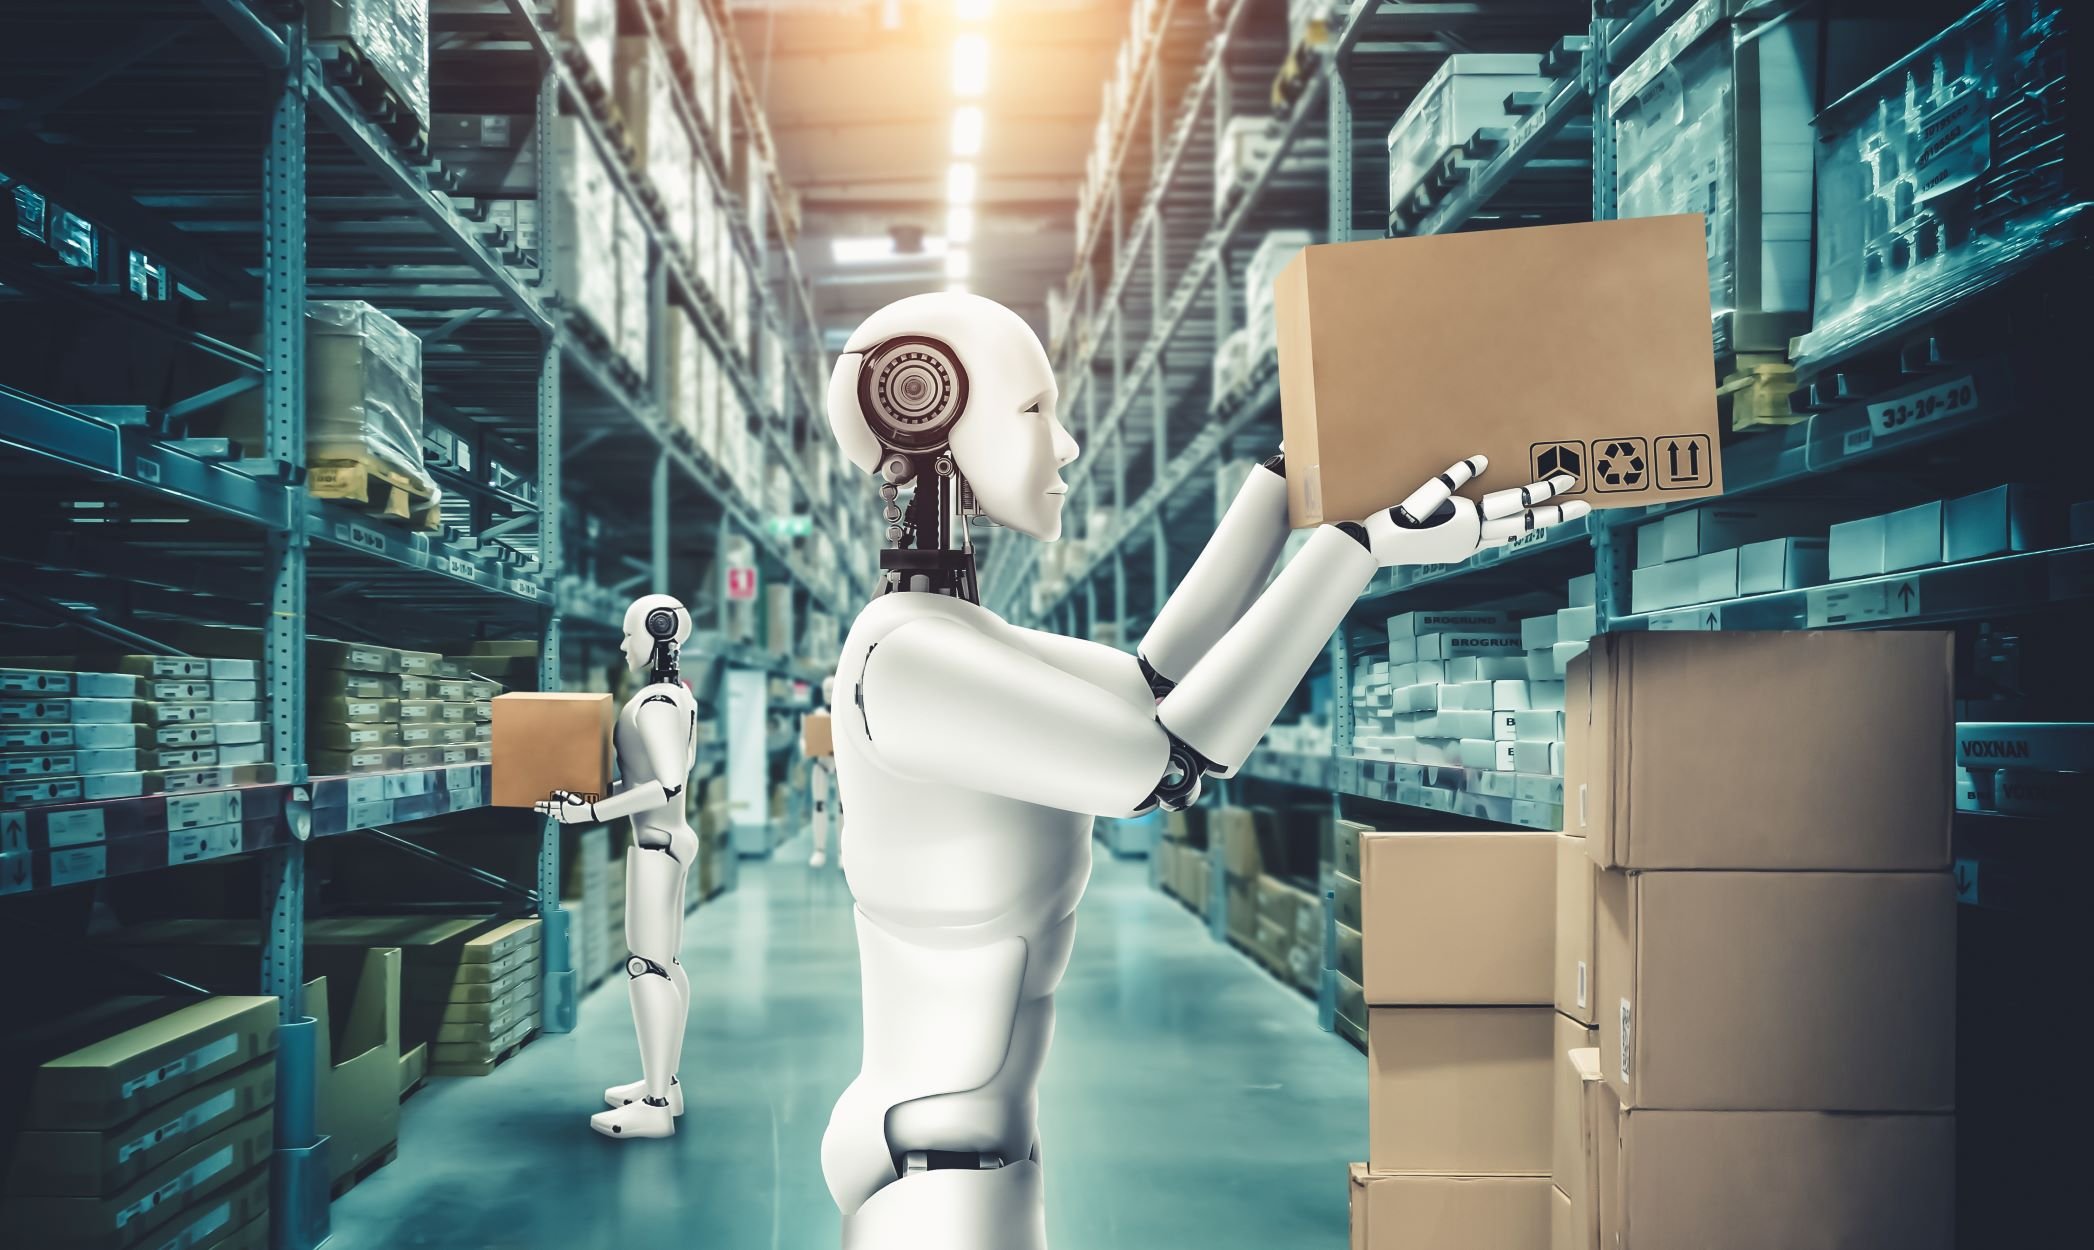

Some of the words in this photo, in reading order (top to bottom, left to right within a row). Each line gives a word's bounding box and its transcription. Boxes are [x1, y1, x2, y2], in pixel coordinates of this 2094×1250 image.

[1424, 616, 1496, 625] BROGRUND
[1451, 638, 1521, 647] BROGRUN
[1962, 740, 2029, 758] VOXNAN
